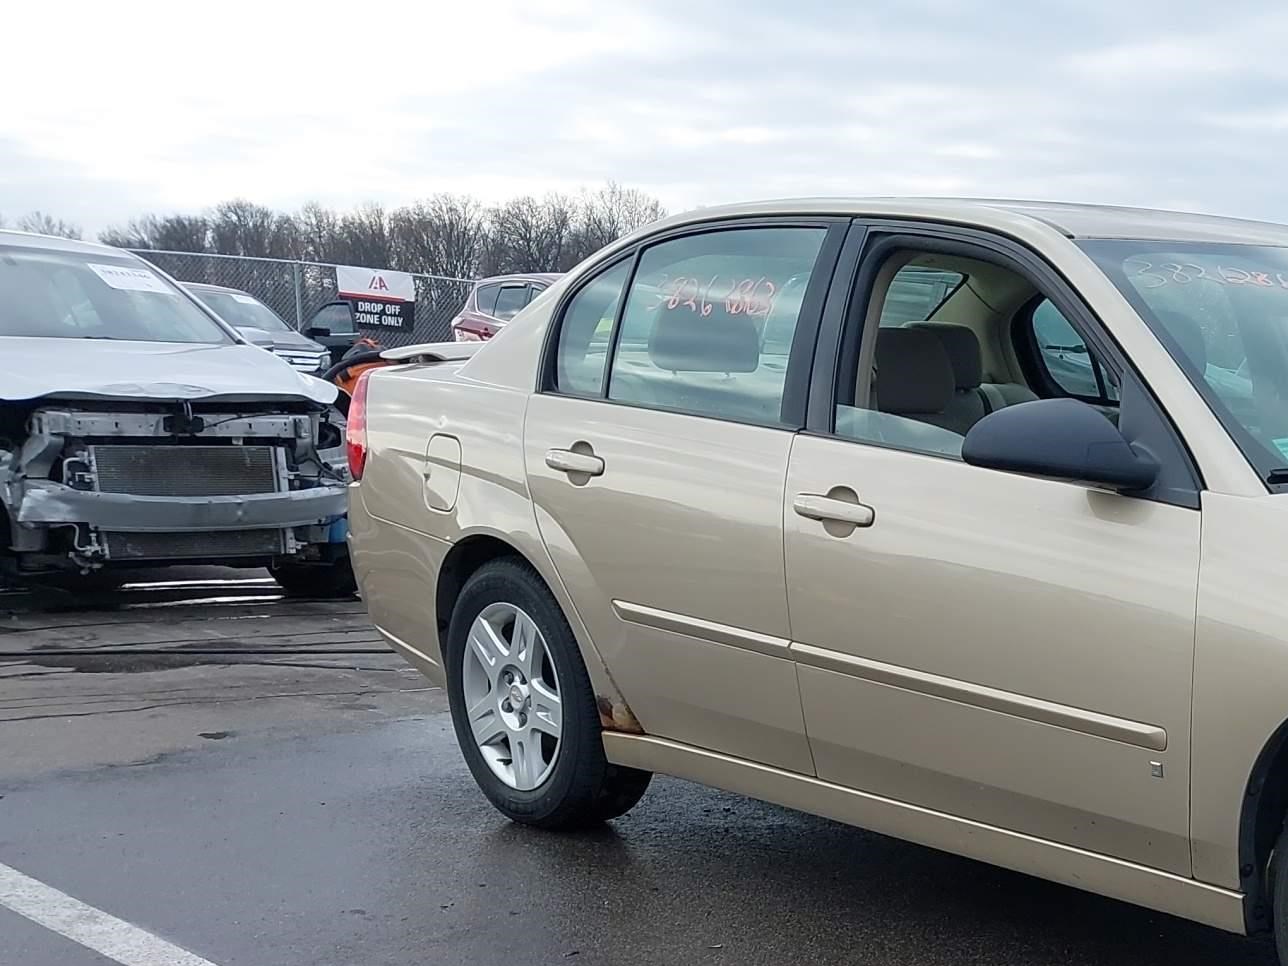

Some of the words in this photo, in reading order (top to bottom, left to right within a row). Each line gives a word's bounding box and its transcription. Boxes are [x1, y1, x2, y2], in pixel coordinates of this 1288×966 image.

[358, 302, 383, 313] DROP
[385, 305, 401, 315] OFF
[355, 313, 380, 324] ZONE
[382, 316, 403, 327] ONLY
